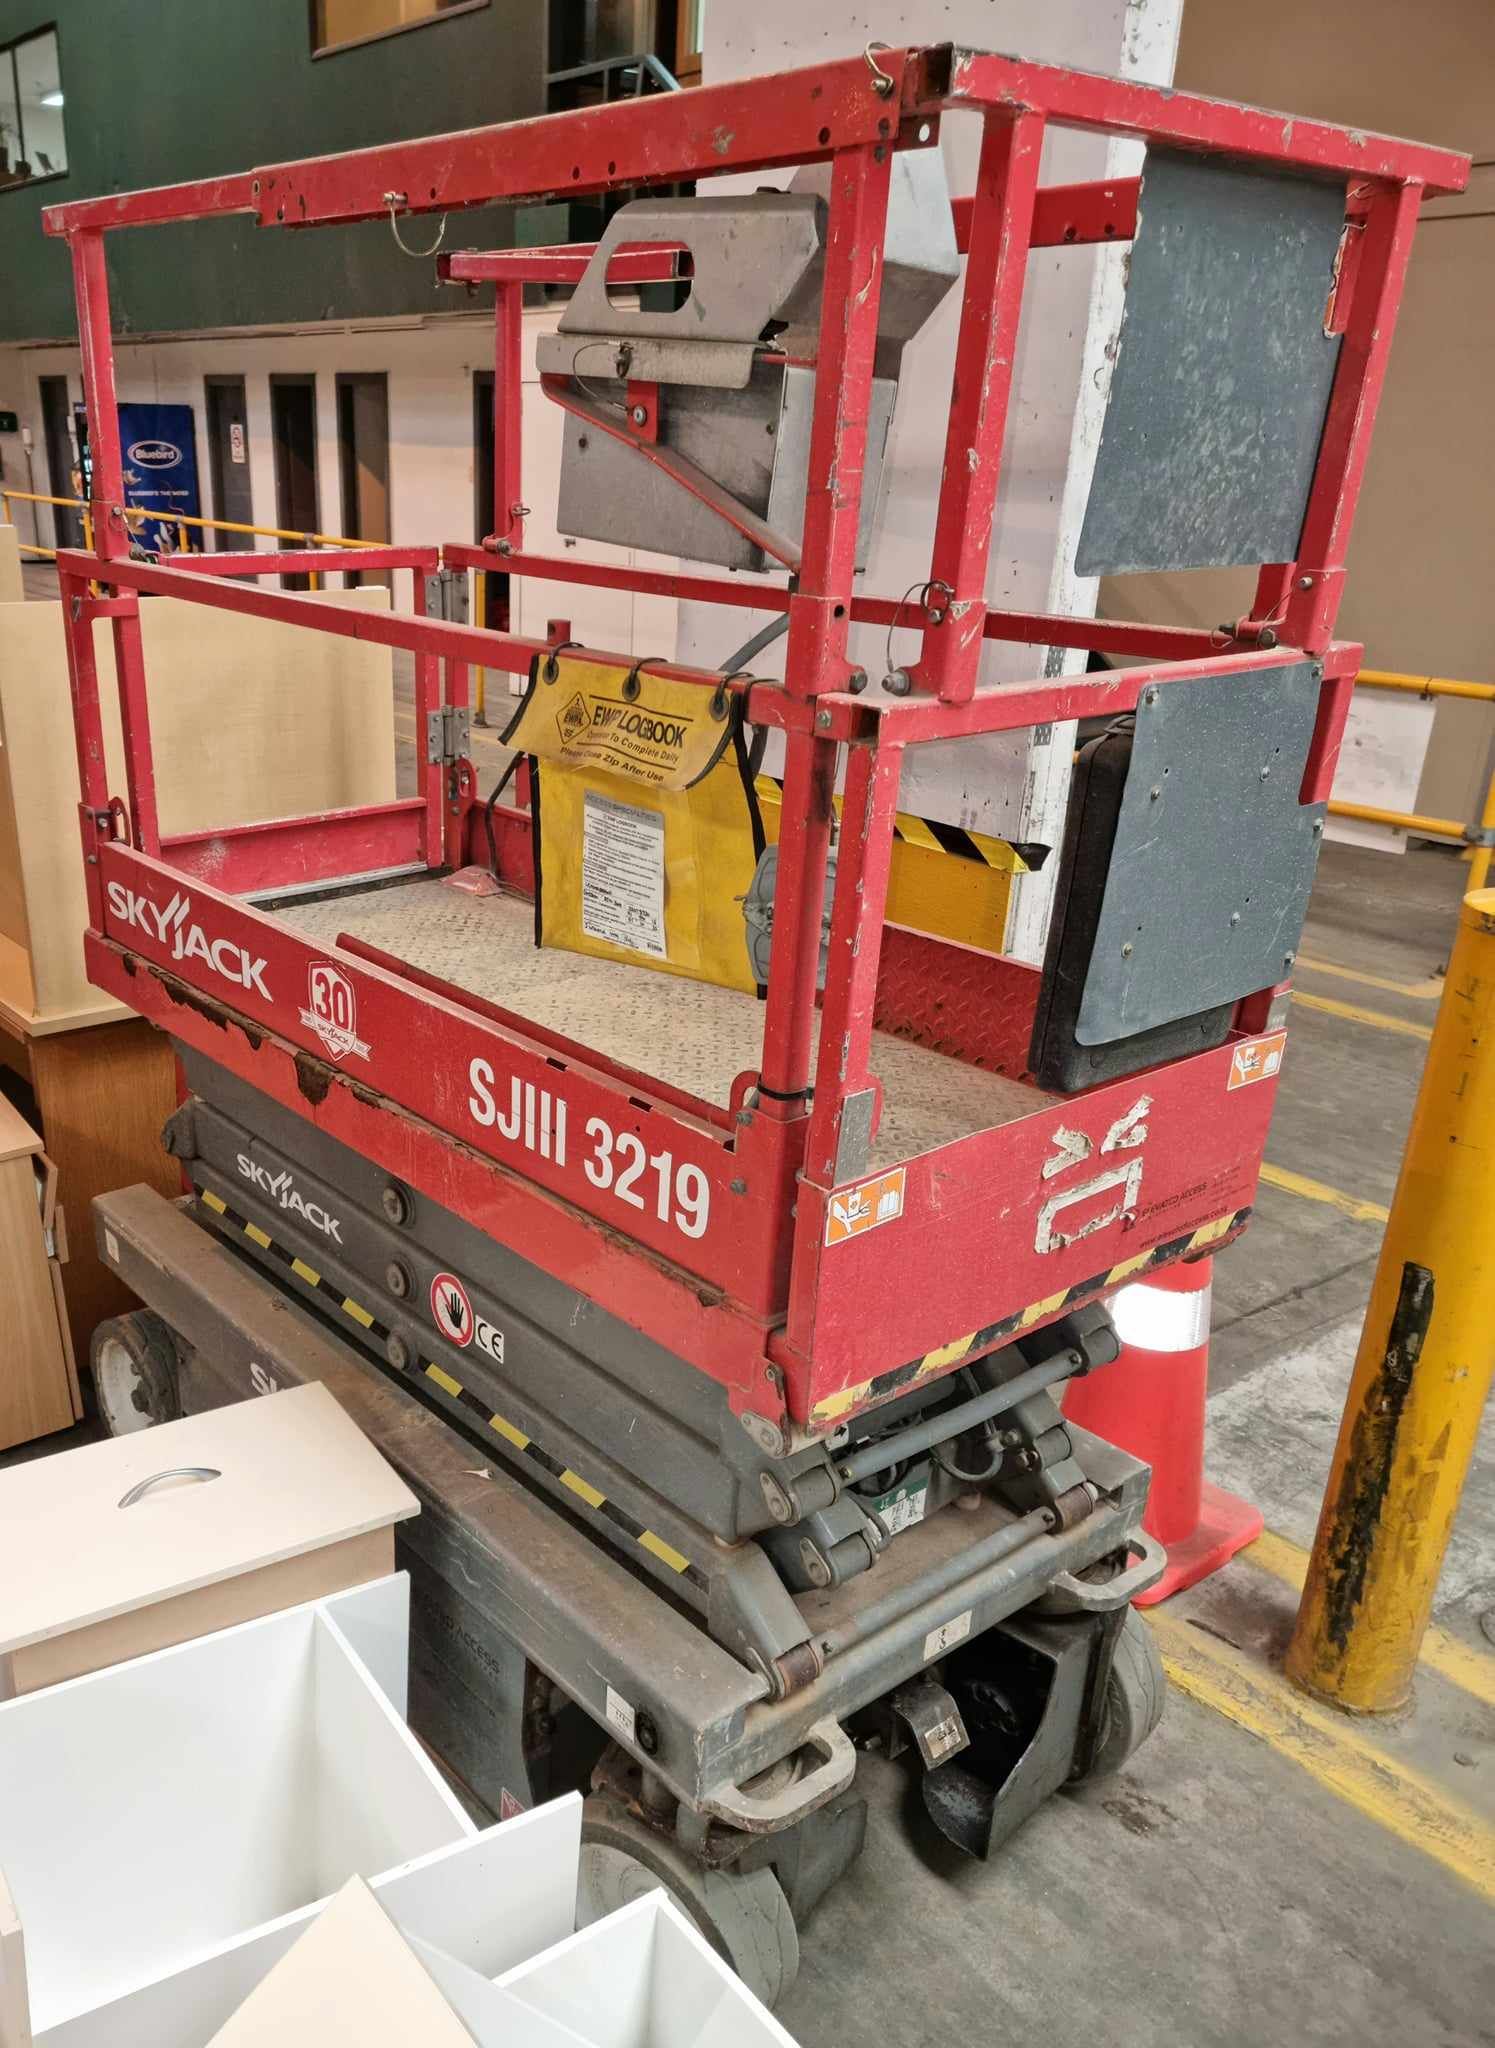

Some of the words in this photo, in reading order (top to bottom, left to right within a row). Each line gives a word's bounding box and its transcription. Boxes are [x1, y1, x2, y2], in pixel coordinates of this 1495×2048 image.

[135, 448, 175, 459] Bluebird
[609, 732, 619, 743] To
[621, 738, 660, 759] Complete
[659, 750, 680, 764] Daily
[617, 710, 687, 748] LOGBOOK
[602, 753, 620, 767] Zip
[621, 762, 646, 777] After
[646, 770, 664, 782] Use
[107, 881, 274, 1003] SKYJACK
[315, 972, 350, 1031] 30
[583, 1117, 710, 1239] 3219
[236, 1153, 344, 1245] SKYJACK
[476, 1323, 503, 1361] CE
